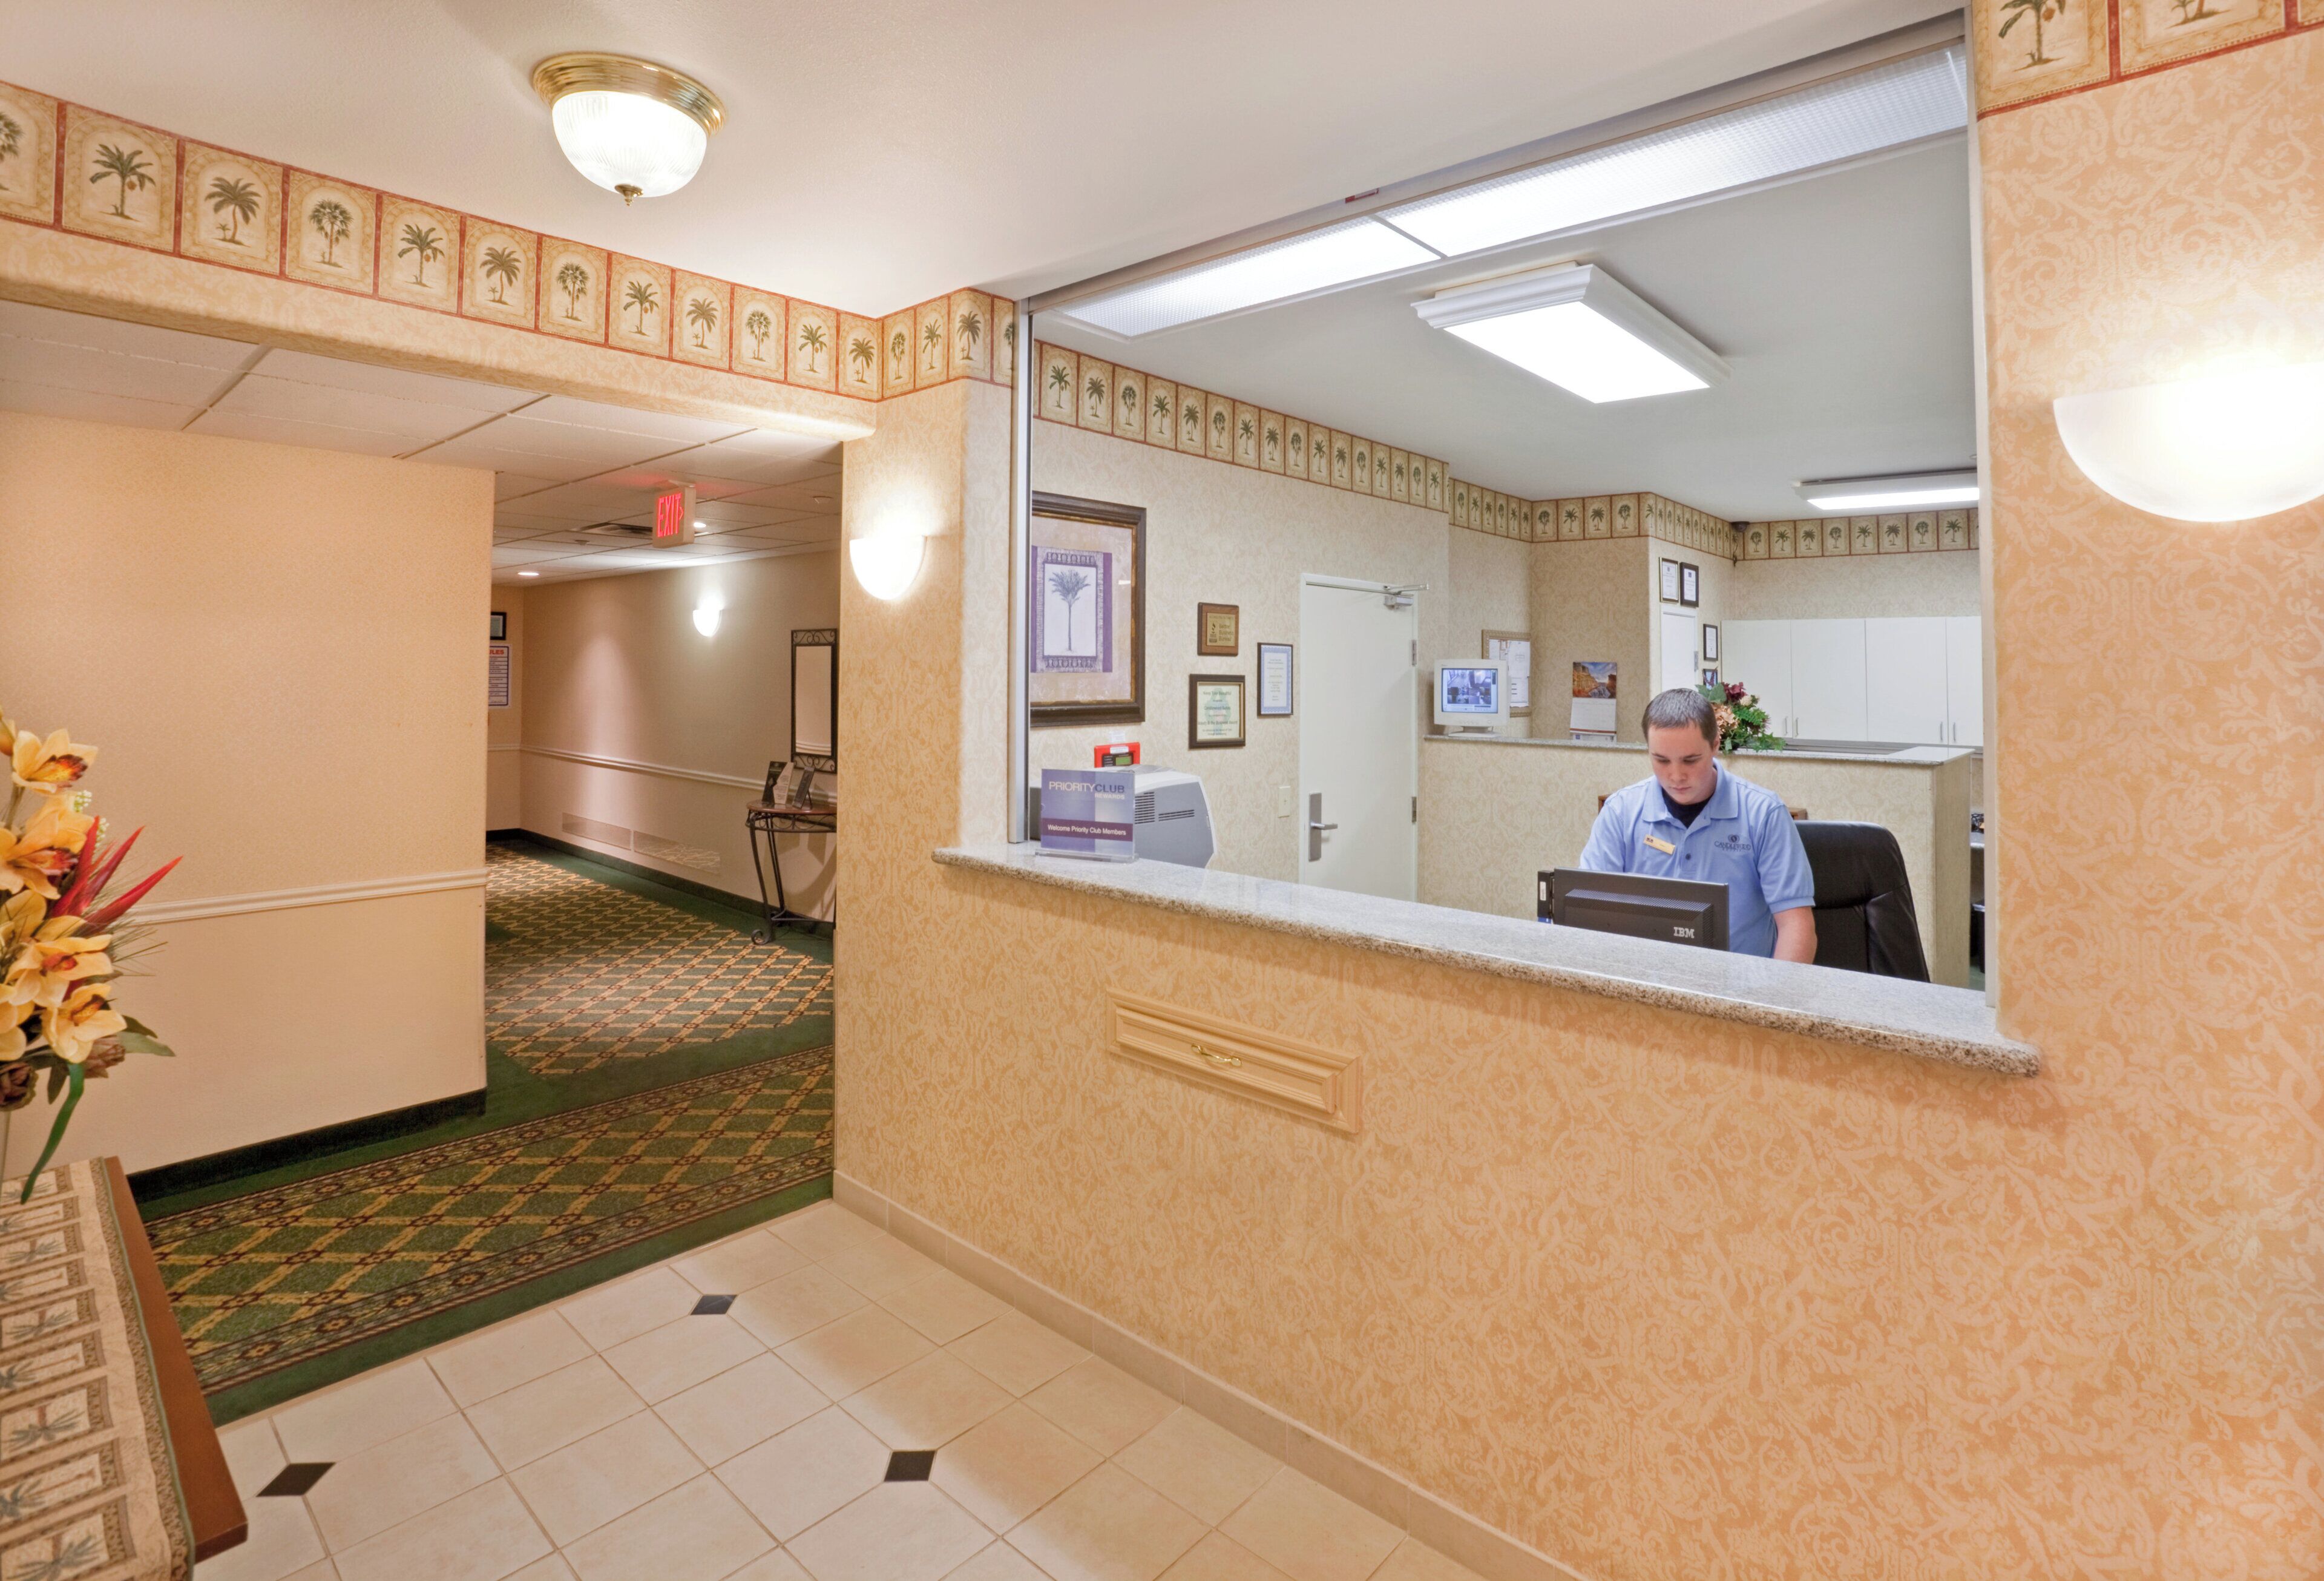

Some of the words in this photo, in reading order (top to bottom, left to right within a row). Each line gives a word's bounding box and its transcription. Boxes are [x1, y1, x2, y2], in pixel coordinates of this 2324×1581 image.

[657, 493, 681, 537] EXIT
[1071, 826, 1089, 834] Priority
[1673, 926, 1695, 938] IBM
